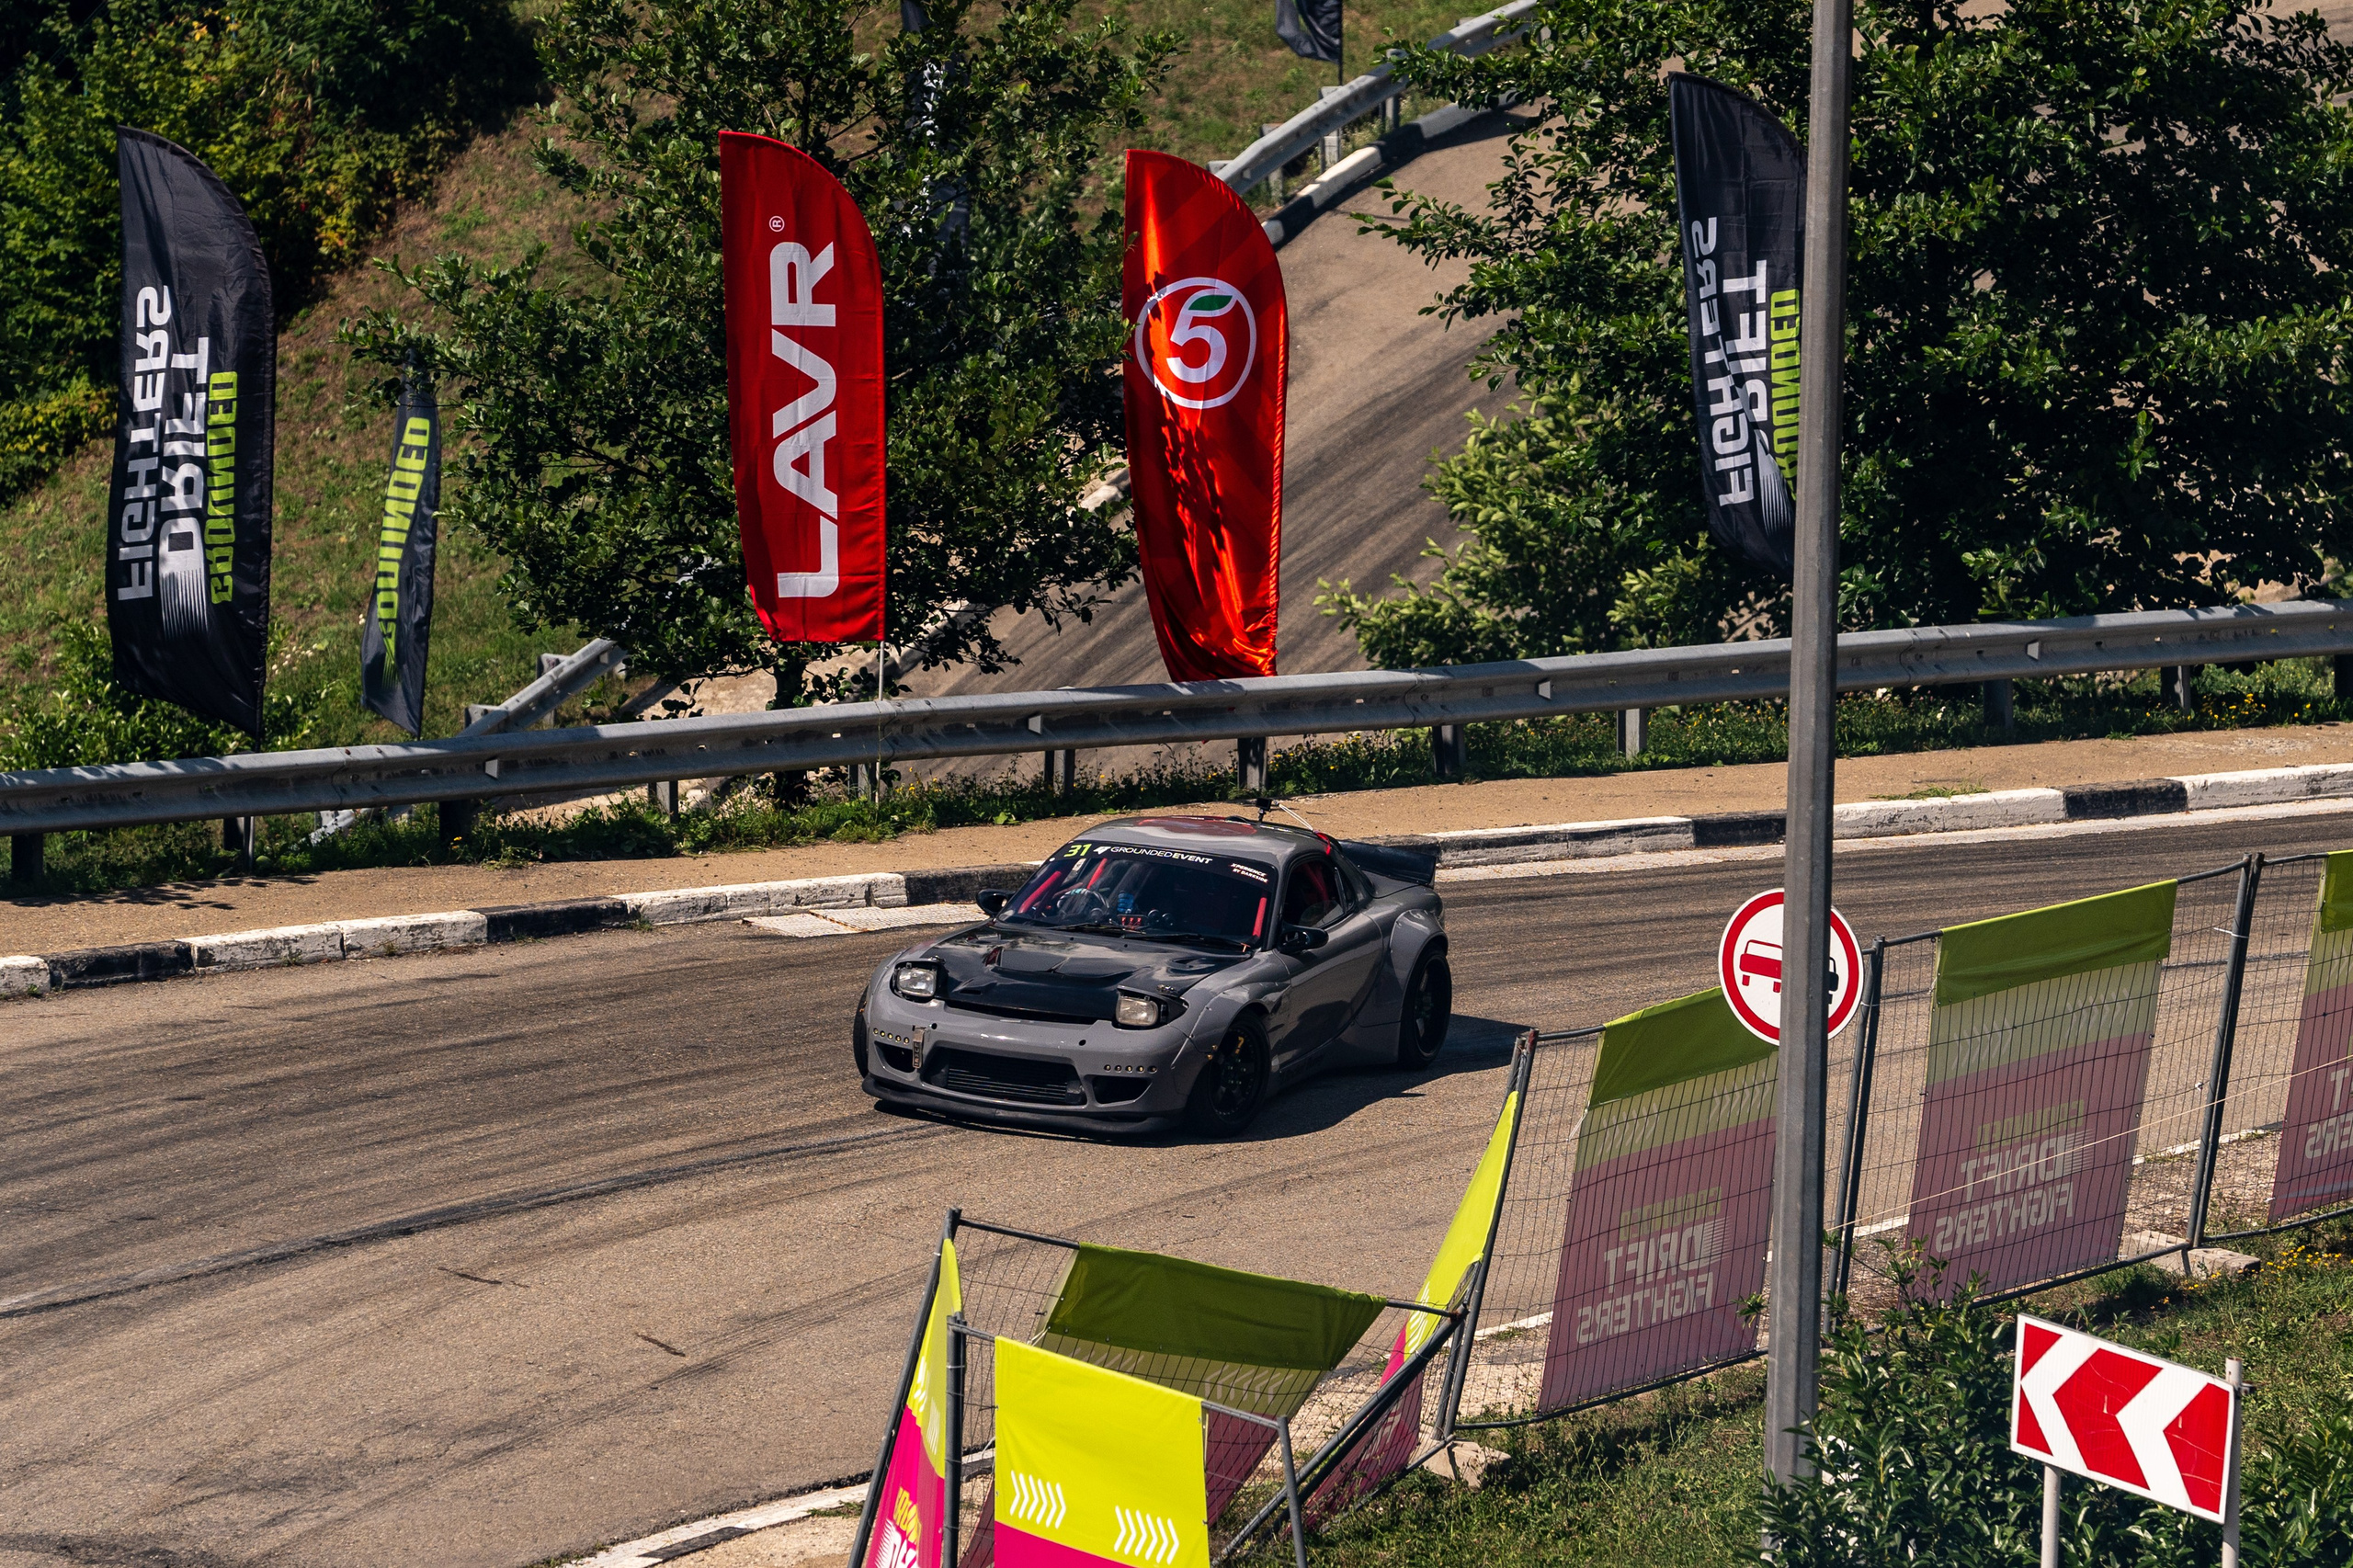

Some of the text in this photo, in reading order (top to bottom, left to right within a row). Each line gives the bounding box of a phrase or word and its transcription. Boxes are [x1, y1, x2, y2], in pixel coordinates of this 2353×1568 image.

[1063, 844, 1092, 858] 31
[1230, 863, 1267, 877] XPERIENCE
[1241, 870, 1268, 883] DARKSIDE
